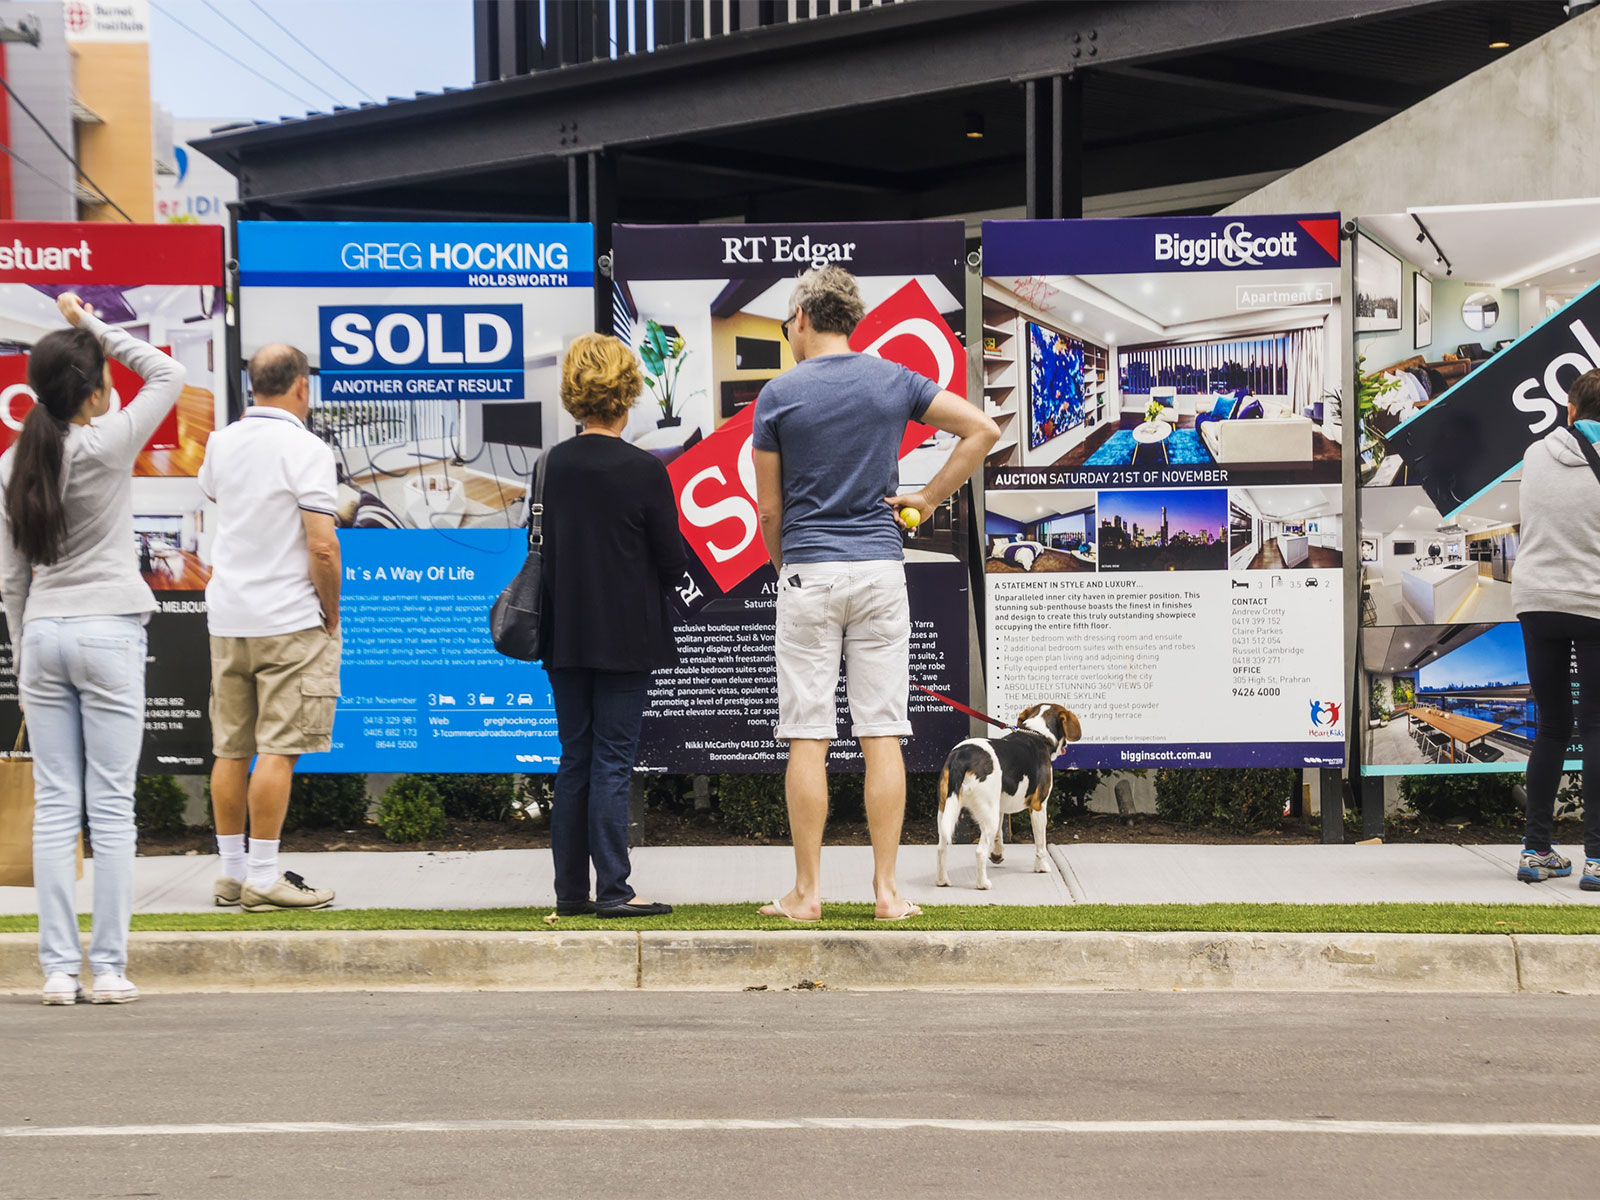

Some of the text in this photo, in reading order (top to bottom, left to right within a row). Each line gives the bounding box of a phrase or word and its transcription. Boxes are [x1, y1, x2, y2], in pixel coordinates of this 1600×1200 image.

[1155, 222, 1297, 266] Biggin & Scott
[341, 243, 568, 270] GREG HOCKING
[722, 235, 856, 268] RT Edgar
[469, 274, 568, 286] HOLDSWORTH
[1241, 289, 1323, 306] Apartment 5
[331, 313, 512, 365] SOLD
[332, 379, 513, 393] ANOTHER GREAT RESULT
[995, 470, 1228, 485] AUCTION SATURDAY 21ST OF NOVEMBER
[375, 567, 387, 580] A
[390, 567, 423, 582] Way
[427, 566, 444, 580] Of
[449, 566, 474, 580] Life
[995, 594, 1044, 602] Unparalleled
[1011, 614, 1036, 622] design
[1089, 612, 1107, 621] truly
[1109, 612, 1154, 621] outstanding
[1156, 612, 1196, 620] showpiece
[1262, 608, 1285, 616] Crotty
[673, 624, 740, 633] exclusive boutique
[703, 634, 735, 643] precinct.
[706, 645, 732, 654] display
[1262, 646, 1304, 655] Cambridge
[918, 652, 938, 660] suite,
[1004, 664, 1022, 673] Fully
[1023, 664, 1057, 672] equipped
[1248, 676, 1266, 685] High
[1267, 676, 1277, 684] St,
[677, 686, 769, 696] panoramic vistas, opulent
[1232, 688, 1280, 696] 9426 4000
[428, 693, 436, 706] 3
[467, 693, 476, 706] 3
[506, 693, 514, 706] 2
[651, 698, 689, 707] promoting
[715, 697, 723, 705] of
[724, 697, 764, 706] prestigious
[1089, 712, 1113, 720] drying
[705, 741, 740, 750] McCarthy
[1121, 750, 1212, 762] bigginscott.com.au
